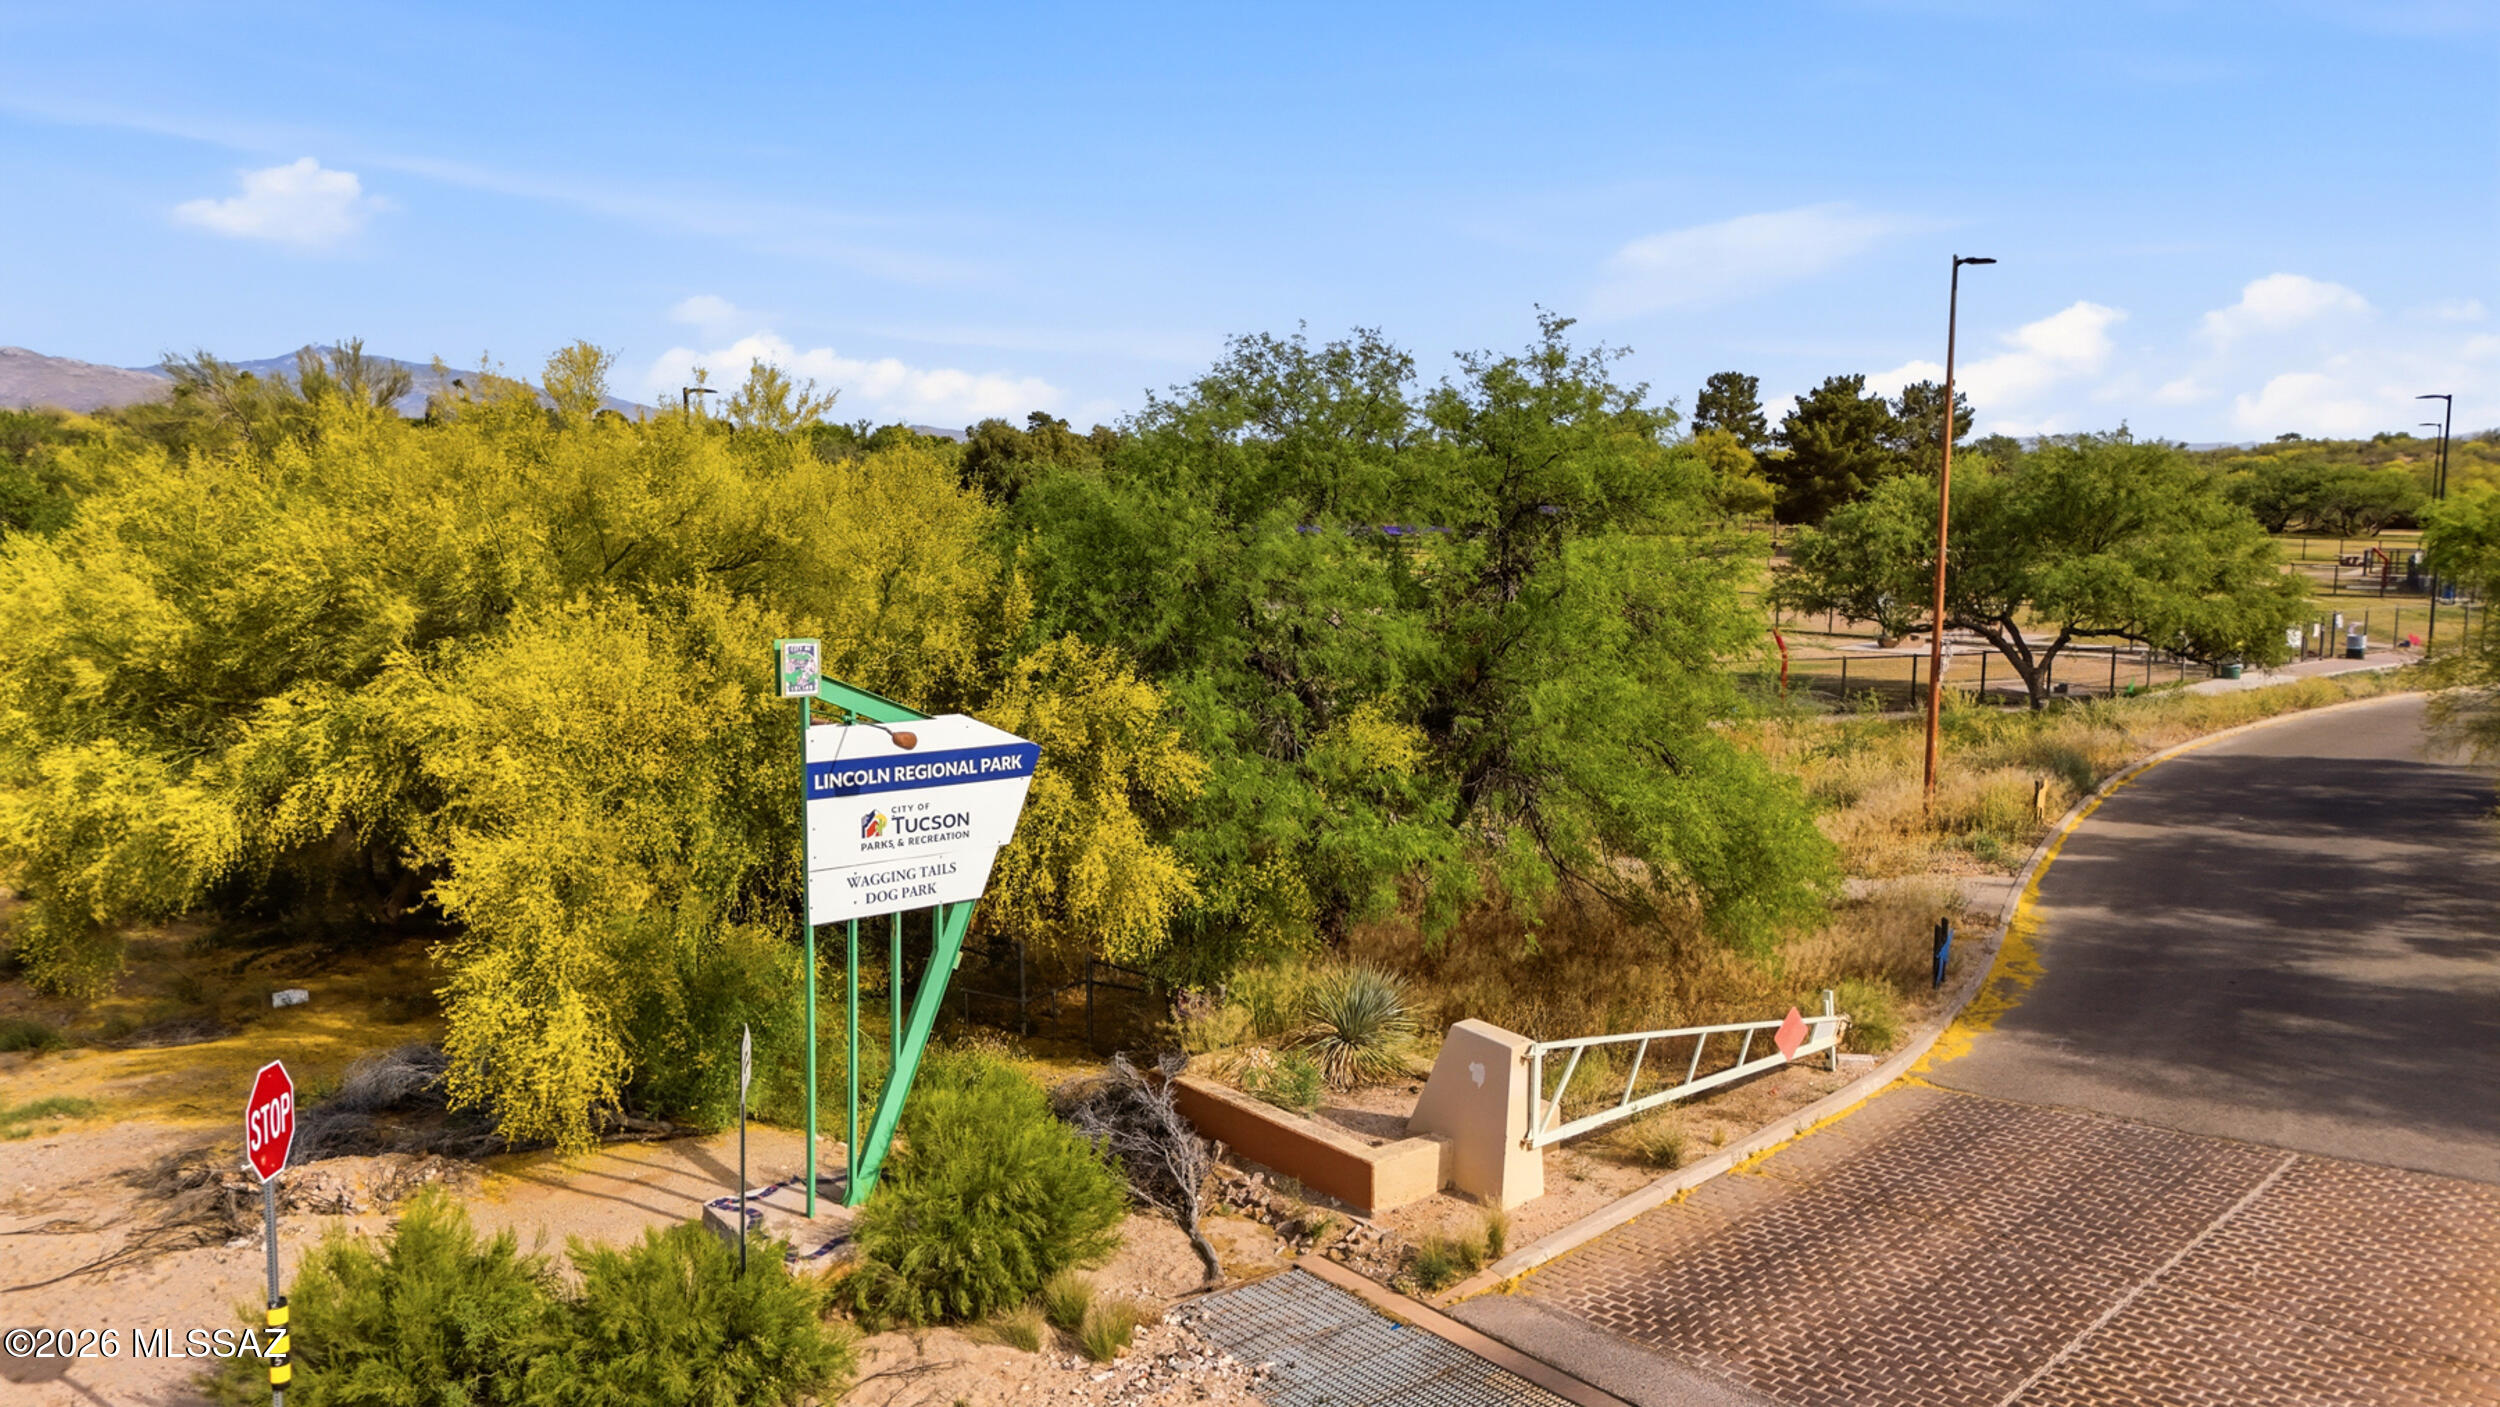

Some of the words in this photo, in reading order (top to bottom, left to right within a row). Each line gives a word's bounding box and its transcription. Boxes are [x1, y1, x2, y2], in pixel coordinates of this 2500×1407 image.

[814, 767, 890, 790] LINCOLN
[894, 759, 978, 782] REGIONAL
[980, 754, 1022, 773] PARK
[891, 804, 914, 814] CITY
[917, 802, 930, 811] OF
[892, 812, 970, 834] TUCSON
[861, 840, 893, 851] PARKS
[897, 838, 905, 847] &
[908, 830, 970, 846] RECREATION
[847, 868, 917, 888] WAGGING
[919, 862, 957, 878] TAILS
[865, 888, 898, 905] DOG
[901, 882, 937, 898] PARK
[251, 1092, 290, 1151] STOP
